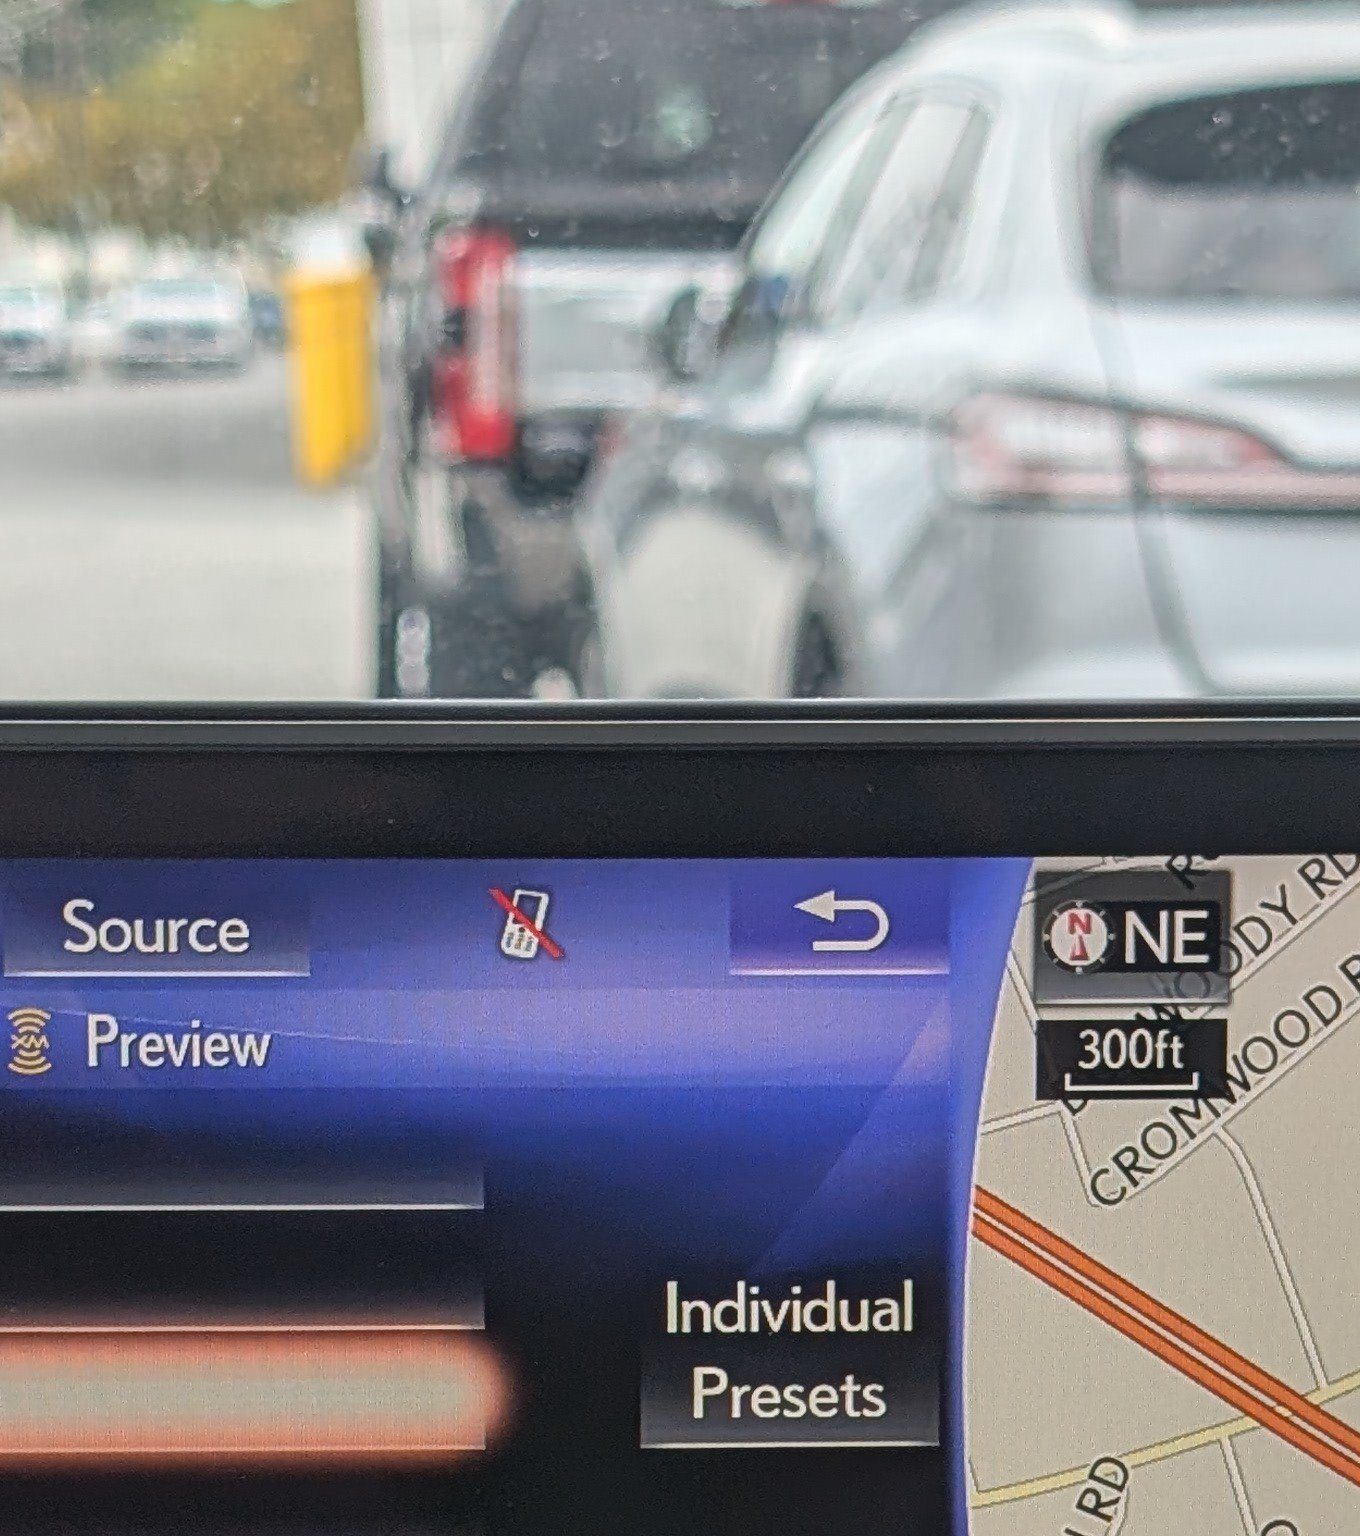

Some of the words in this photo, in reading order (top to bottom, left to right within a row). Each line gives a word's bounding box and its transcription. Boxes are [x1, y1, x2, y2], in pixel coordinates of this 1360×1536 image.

[62, 898, 251, 955] Source
[1123, 909, 1210, 964] NE
[86, 1011, 272, 1069] Preview
[1077, 1028, 1185, 1069] 300ft
[1090, 984, 1342, 1207] CROMWOOD
[666, 1279, 914, 1334] Individual
[692, 1366, 888, 1419] Presets
[1076, 1456, 1130, 1522] RD
